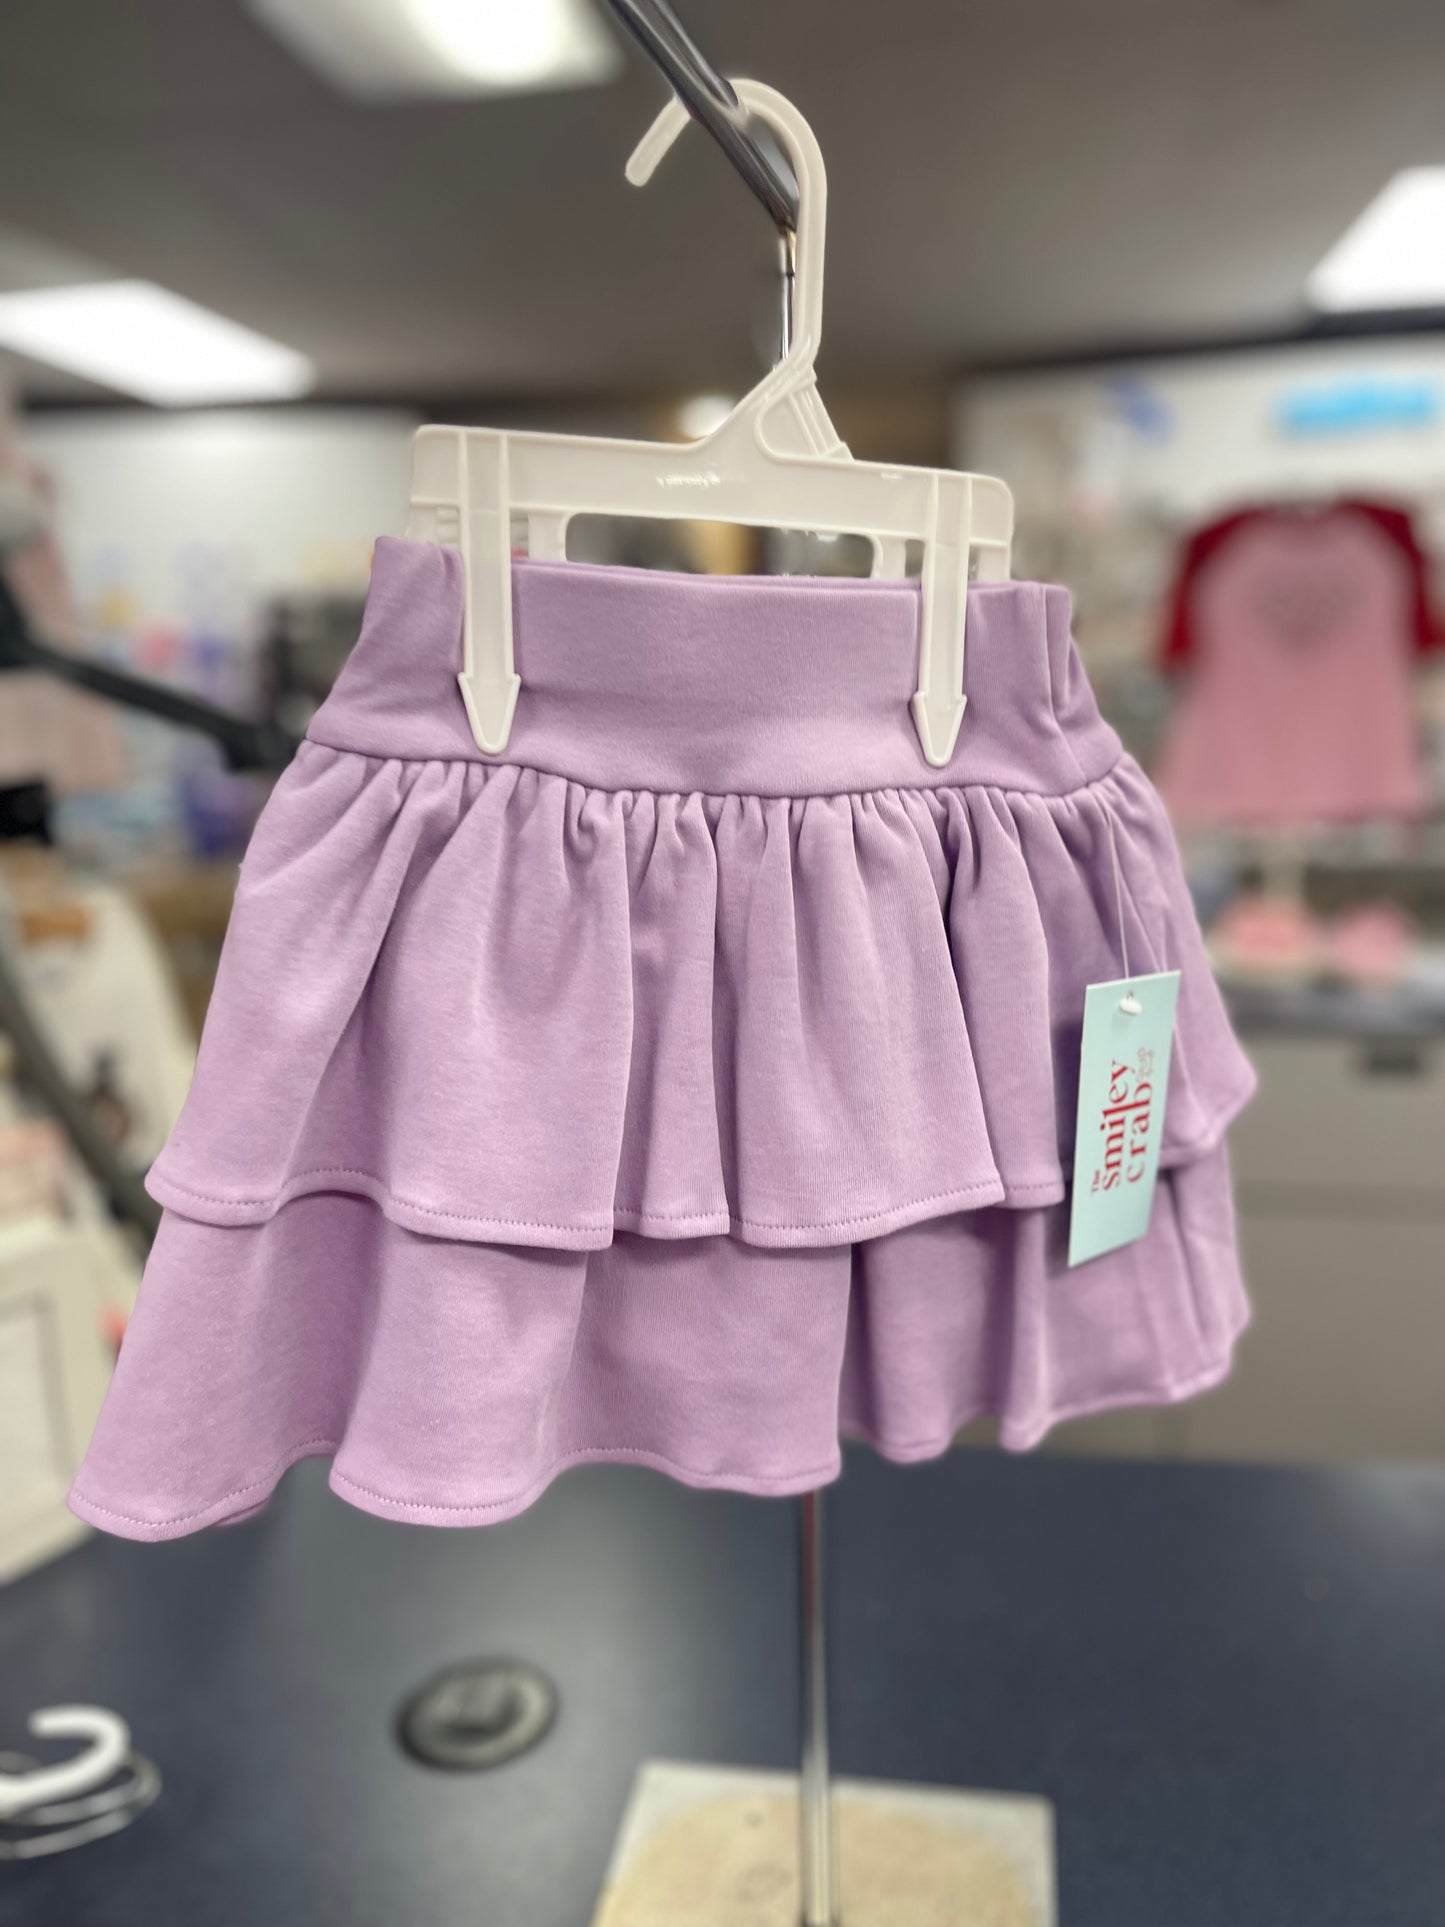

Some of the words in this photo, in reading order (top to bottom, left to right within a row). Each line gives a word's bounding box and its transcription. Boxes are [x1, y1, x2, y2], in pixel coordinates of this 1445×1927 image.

[1100, 1059, 1136, 1191] smiley
[1125, 1082, 1152, 1183] crab
[1091, 1168, 1101, 1194] The
